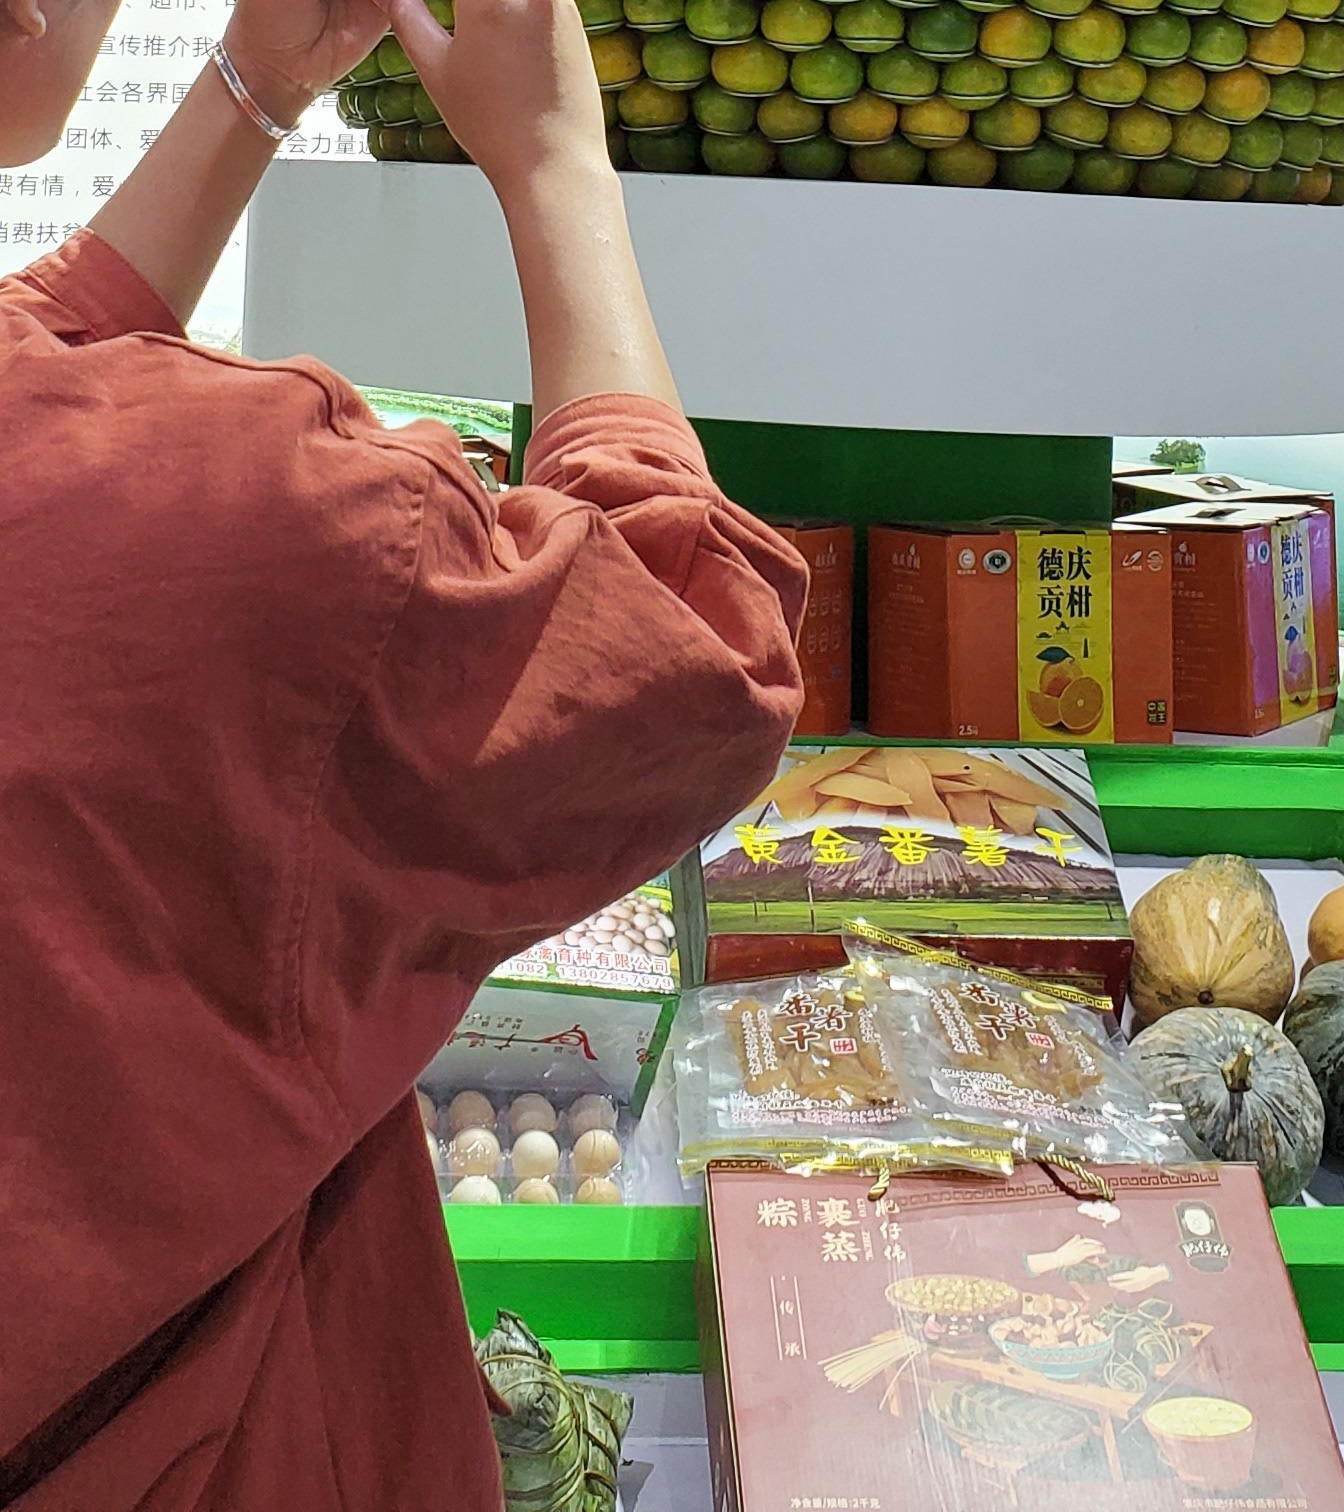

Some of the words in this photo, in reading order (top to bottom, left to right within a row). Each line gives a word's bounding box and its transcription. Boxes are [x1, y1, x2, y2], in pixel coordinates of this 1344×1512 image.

[275, 132, 373, 155] 会力量
[1036, 545, 1093, 582] 德庆
[1036, 583, 1093, 620] 贡柑
[756, 1197, 798, 1228] 粽
[816, 1197, 863, 1263] 裹蒸
